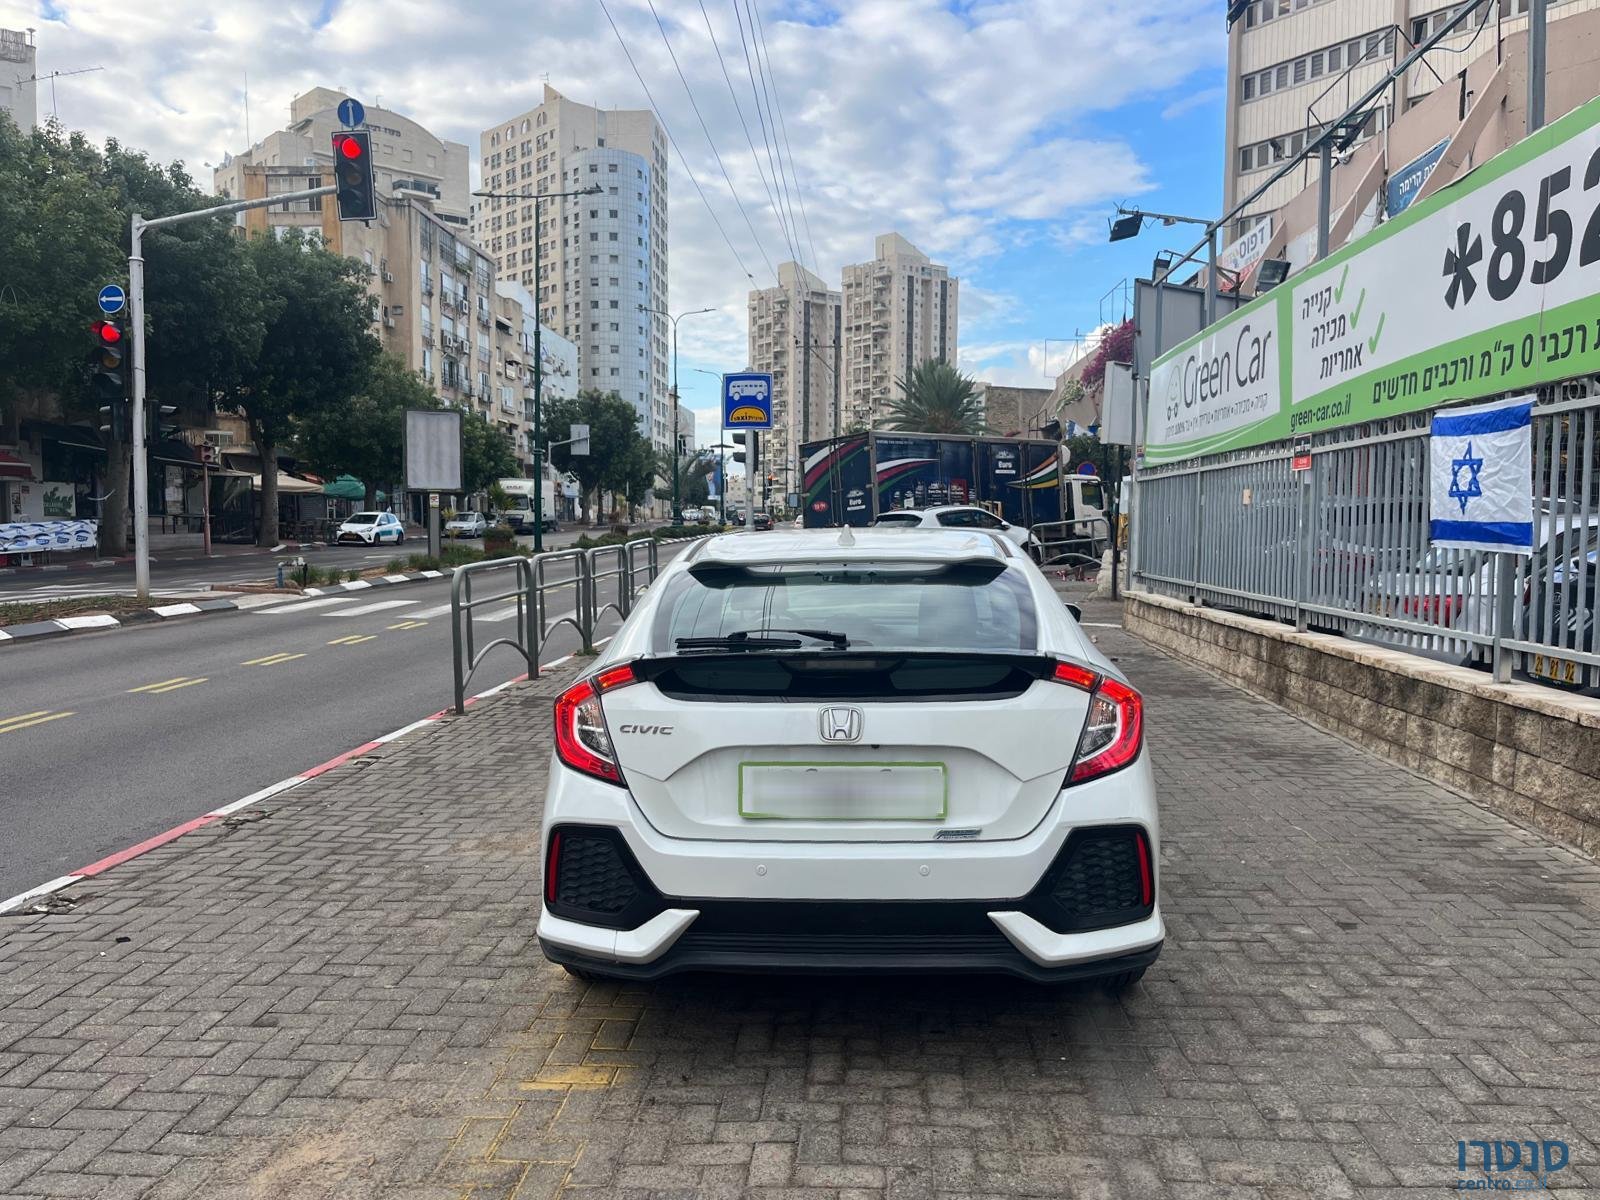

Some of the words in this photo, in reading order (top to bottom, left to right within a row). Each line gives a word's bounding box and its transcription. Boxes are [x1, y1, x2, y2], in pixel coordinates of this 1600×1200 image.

[1239, 227, 1265, 258] דפוס
[1302, 286, 1332, 320] קנייה
[1311, 313, 1346, 349] מכירה
[1540, 324, 1587, 362] רכבי
[1184, 355, 1231, 408] Green
[1236, 325, 1272, 387] Car
[1320, 342, 1364, 380] אחריות
[1521, 333, 1534, 368] 0
[1372, 371, 1418, 404] חדשים
[1422, 354, 1474, 392] ורכבים
[620, 724, 674, 735] CIVIC
